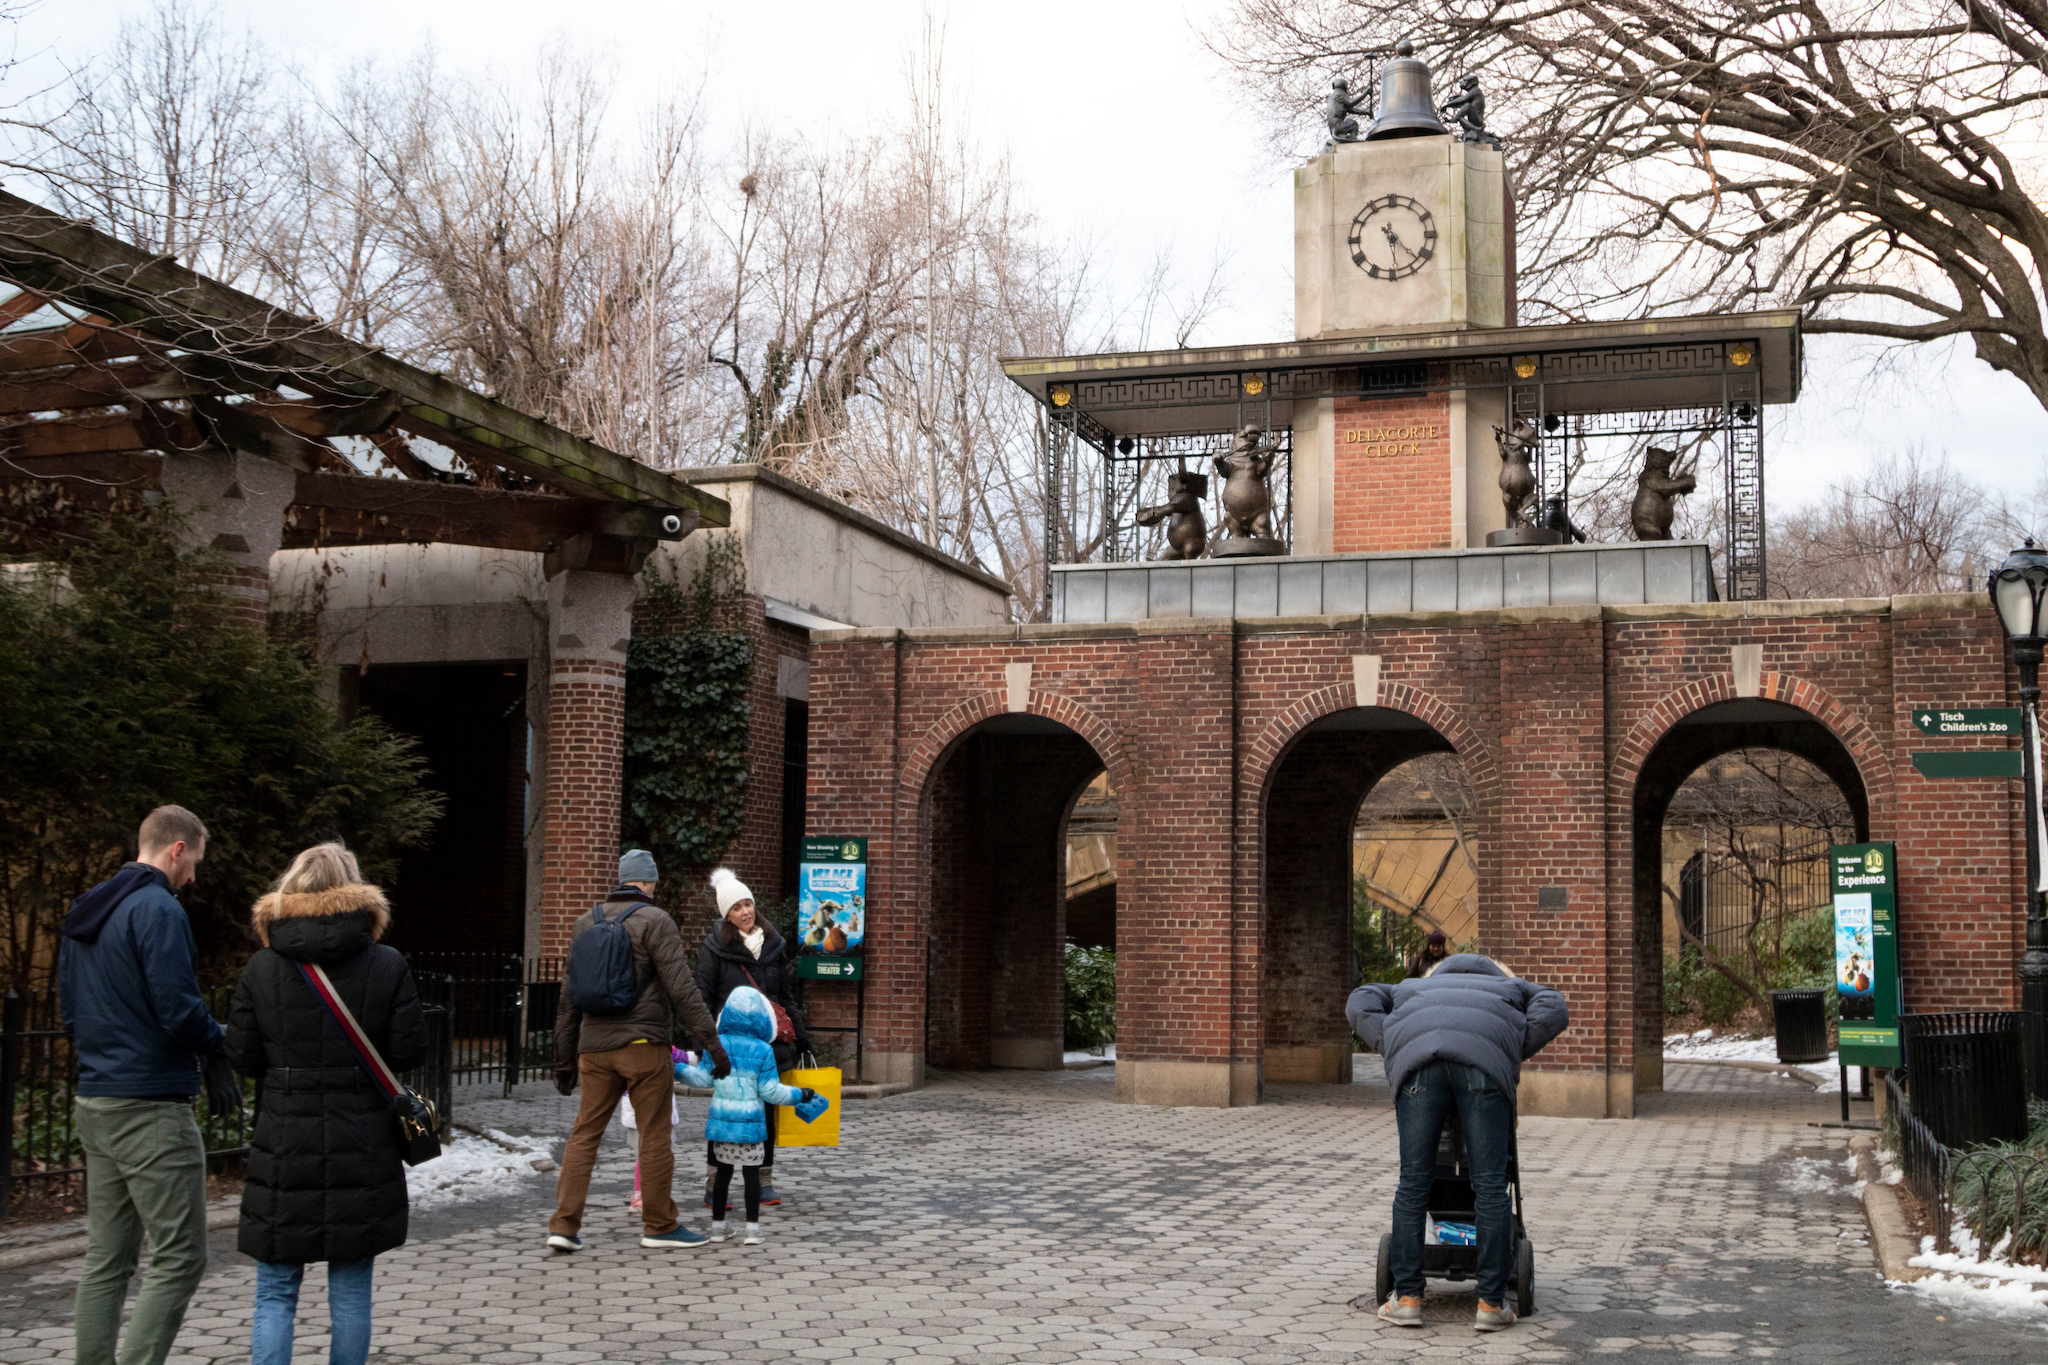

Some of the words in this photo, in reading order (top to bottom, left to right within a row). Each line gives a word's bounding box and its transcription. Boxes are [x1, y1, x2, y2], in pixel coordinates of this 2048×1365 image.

[1347, 426, 1438, 443] DELACORTE
[1365, 442, 1422, 458] CLOCK
[1940, 712, 1965, 722] Tisch
[1940, 722, 1987, 732] Children's
[1989, 722, 2008, 732] Zoo
[1838, 857, 1862, 865] Welcome
[1845, 865, 1855, 873] the
[1838, 874, 1886, 888] Experience
[817, 966, 840, 975] THEATER
